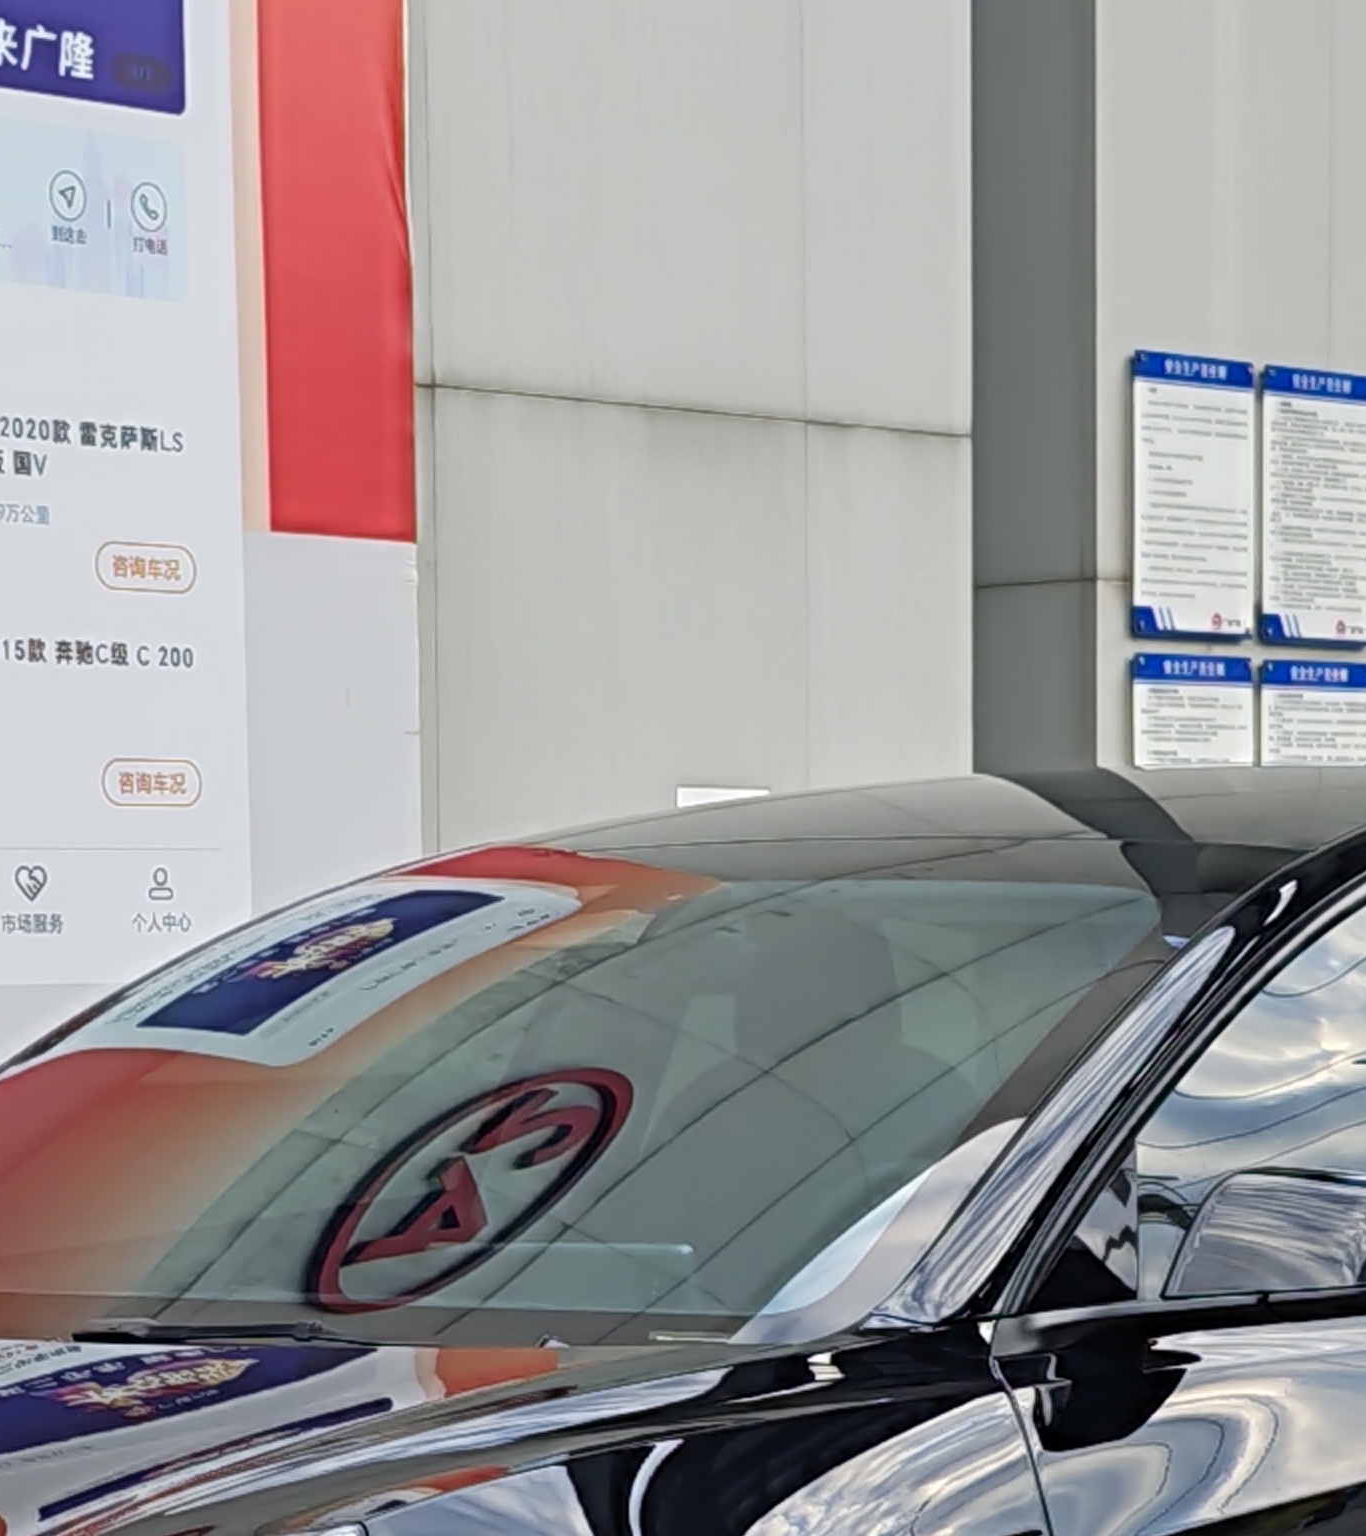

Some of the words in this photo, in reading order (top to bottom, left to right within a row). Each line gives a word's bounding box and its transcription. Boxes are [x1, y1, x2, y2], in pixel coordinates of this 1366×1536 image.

[0, 415, 71, 445] 2020款
[79, 420, 184, 453] 雷克萨斯LS
[12, 450, 48, 477] 国V
[112, 554, 182, 582] 咨询车况
[55, 640, 130, 667] 奔驰C级
[136, 646, 150, 666] C
[158, 646, 194, 668] 200
[118, 771, 187, 796] 咨询车况
[0, 912, 64, 934] 市场服务
[131, 912, 192, 932] 个人中心
